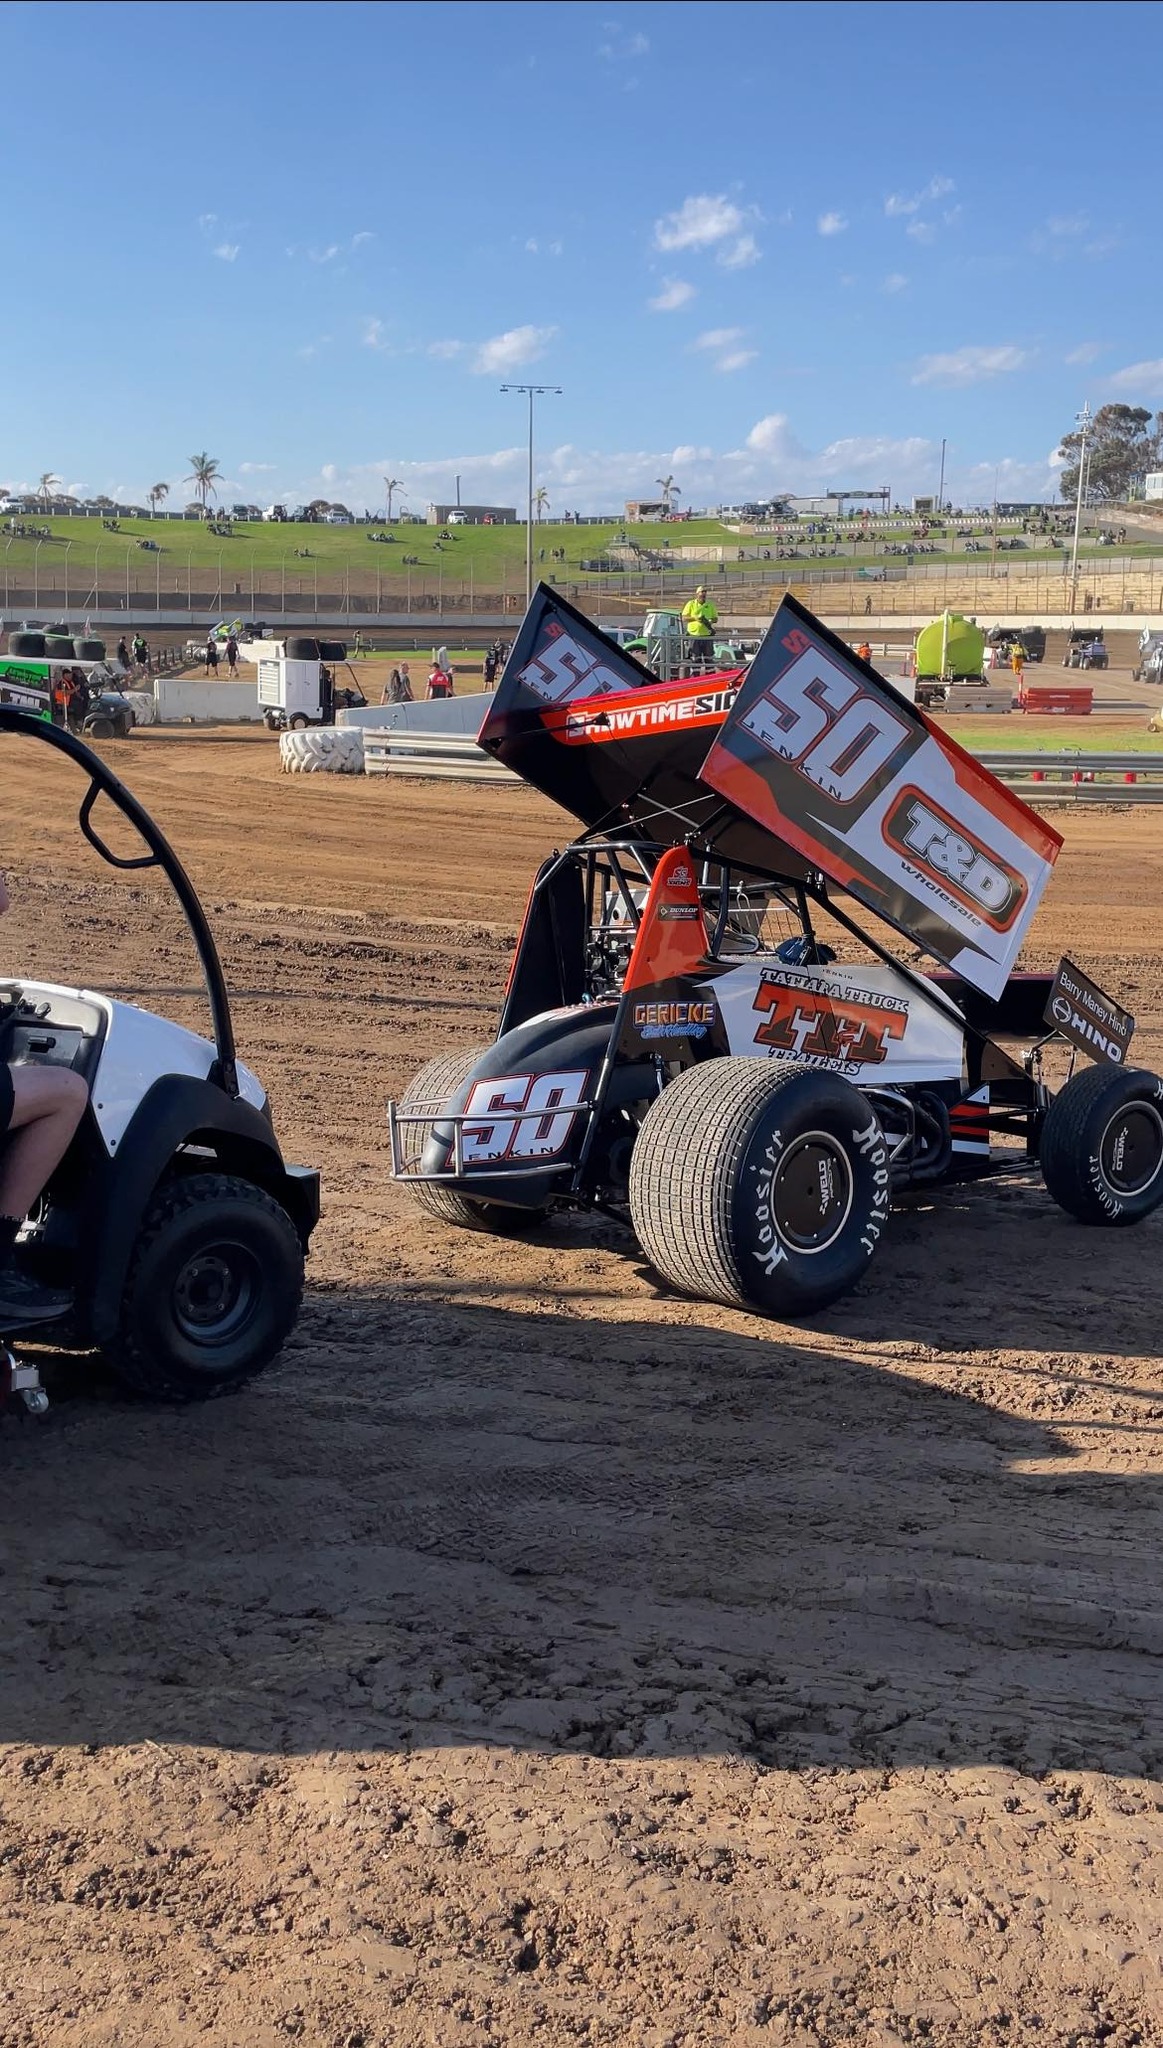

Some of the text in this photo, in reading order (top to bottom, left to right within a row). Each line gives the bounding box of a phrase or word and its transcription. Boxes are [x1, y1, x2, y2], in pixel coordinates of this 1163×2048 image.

[735, 643, 914, 806] 50
[741, 720, 843, 800] JENKIN
[903, 801, 1013, 913] T&D
[900, 861, 982, 927] wholesale
[634, 1003, 714, 1025] GERICKE
[845, 986, 910, 1013] TRUCK
[1059, 971, 1127, 1036] Barry Maney Hino
[1071, 1012, 1122, 1063] HINO
[445, 1068, 591, 1168] 50
[468, 1146, 556, 1162] ENKIN
[852, 1115, 890, 1256] Hoosier
[1087, 1154, 1124, 1220] Hoosier
[750, 1129, 789, 1276] Hoosier
